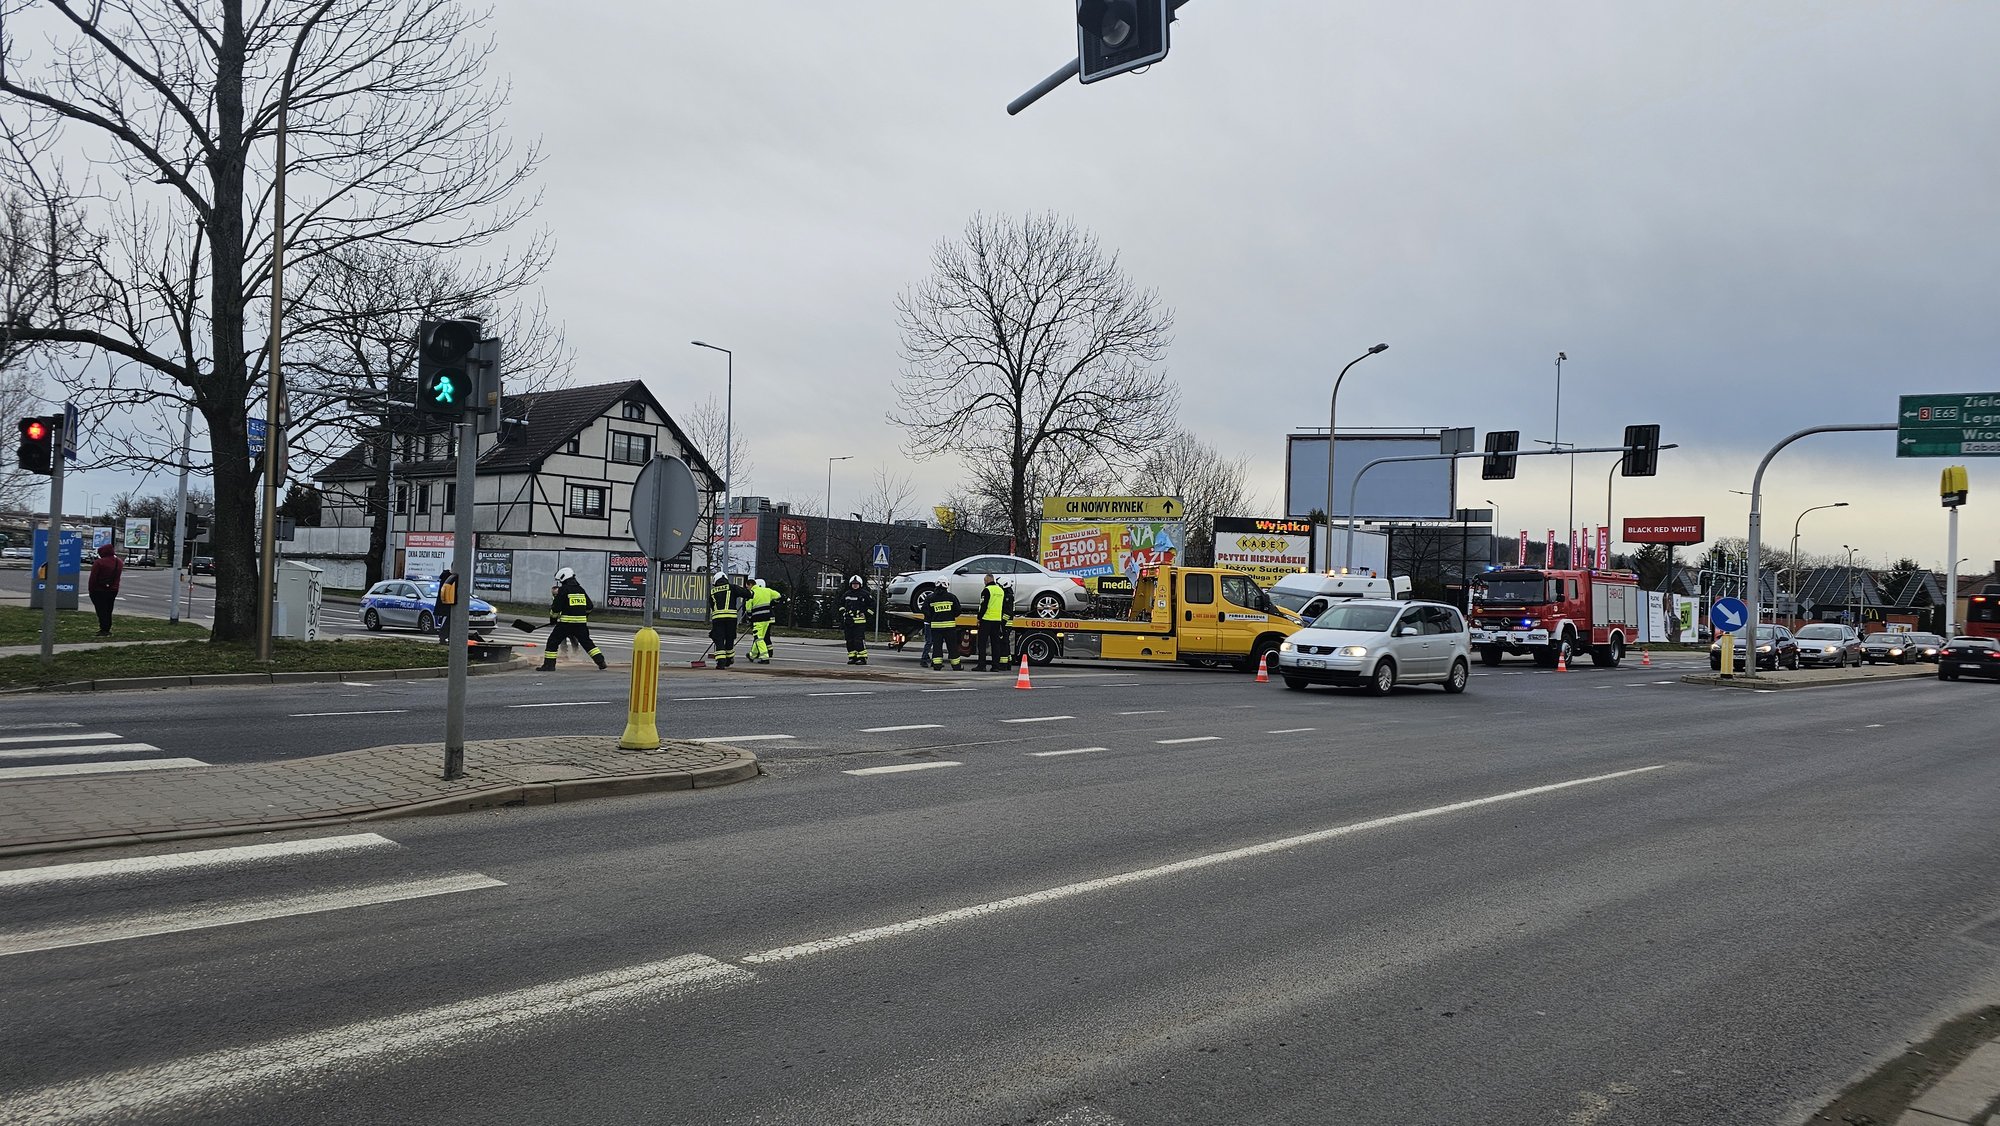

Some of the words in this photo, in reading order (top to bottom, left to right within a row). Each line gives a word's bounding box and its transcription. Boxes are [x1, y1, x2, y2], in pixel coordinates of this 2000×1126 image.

[1935, 409, 1956, 418] E65
[1066, 501, 1079, 513] CH
[1081, 501, 1110, 513] NOWY
[1112, 501, 1144, 513] RYNEK
[783, 533, 796, 541] RED
[1052, 532, 1080, 542] ZREALIZUJ
[1061, 539, 1096, 556] 2500
[1242, 540, 1285, 549] KABET
[1063, 552, 1108, 568] LAPTOP
[1217, 552, 1248, 562] PŁYTKI
[1250, 554, 1306, 565] HISZPAŃSKIE
[1031, 620, 1046, 628] 605
[1047, 621, 1062, 629] 330
[1064, 621, 1079, 629] 000
